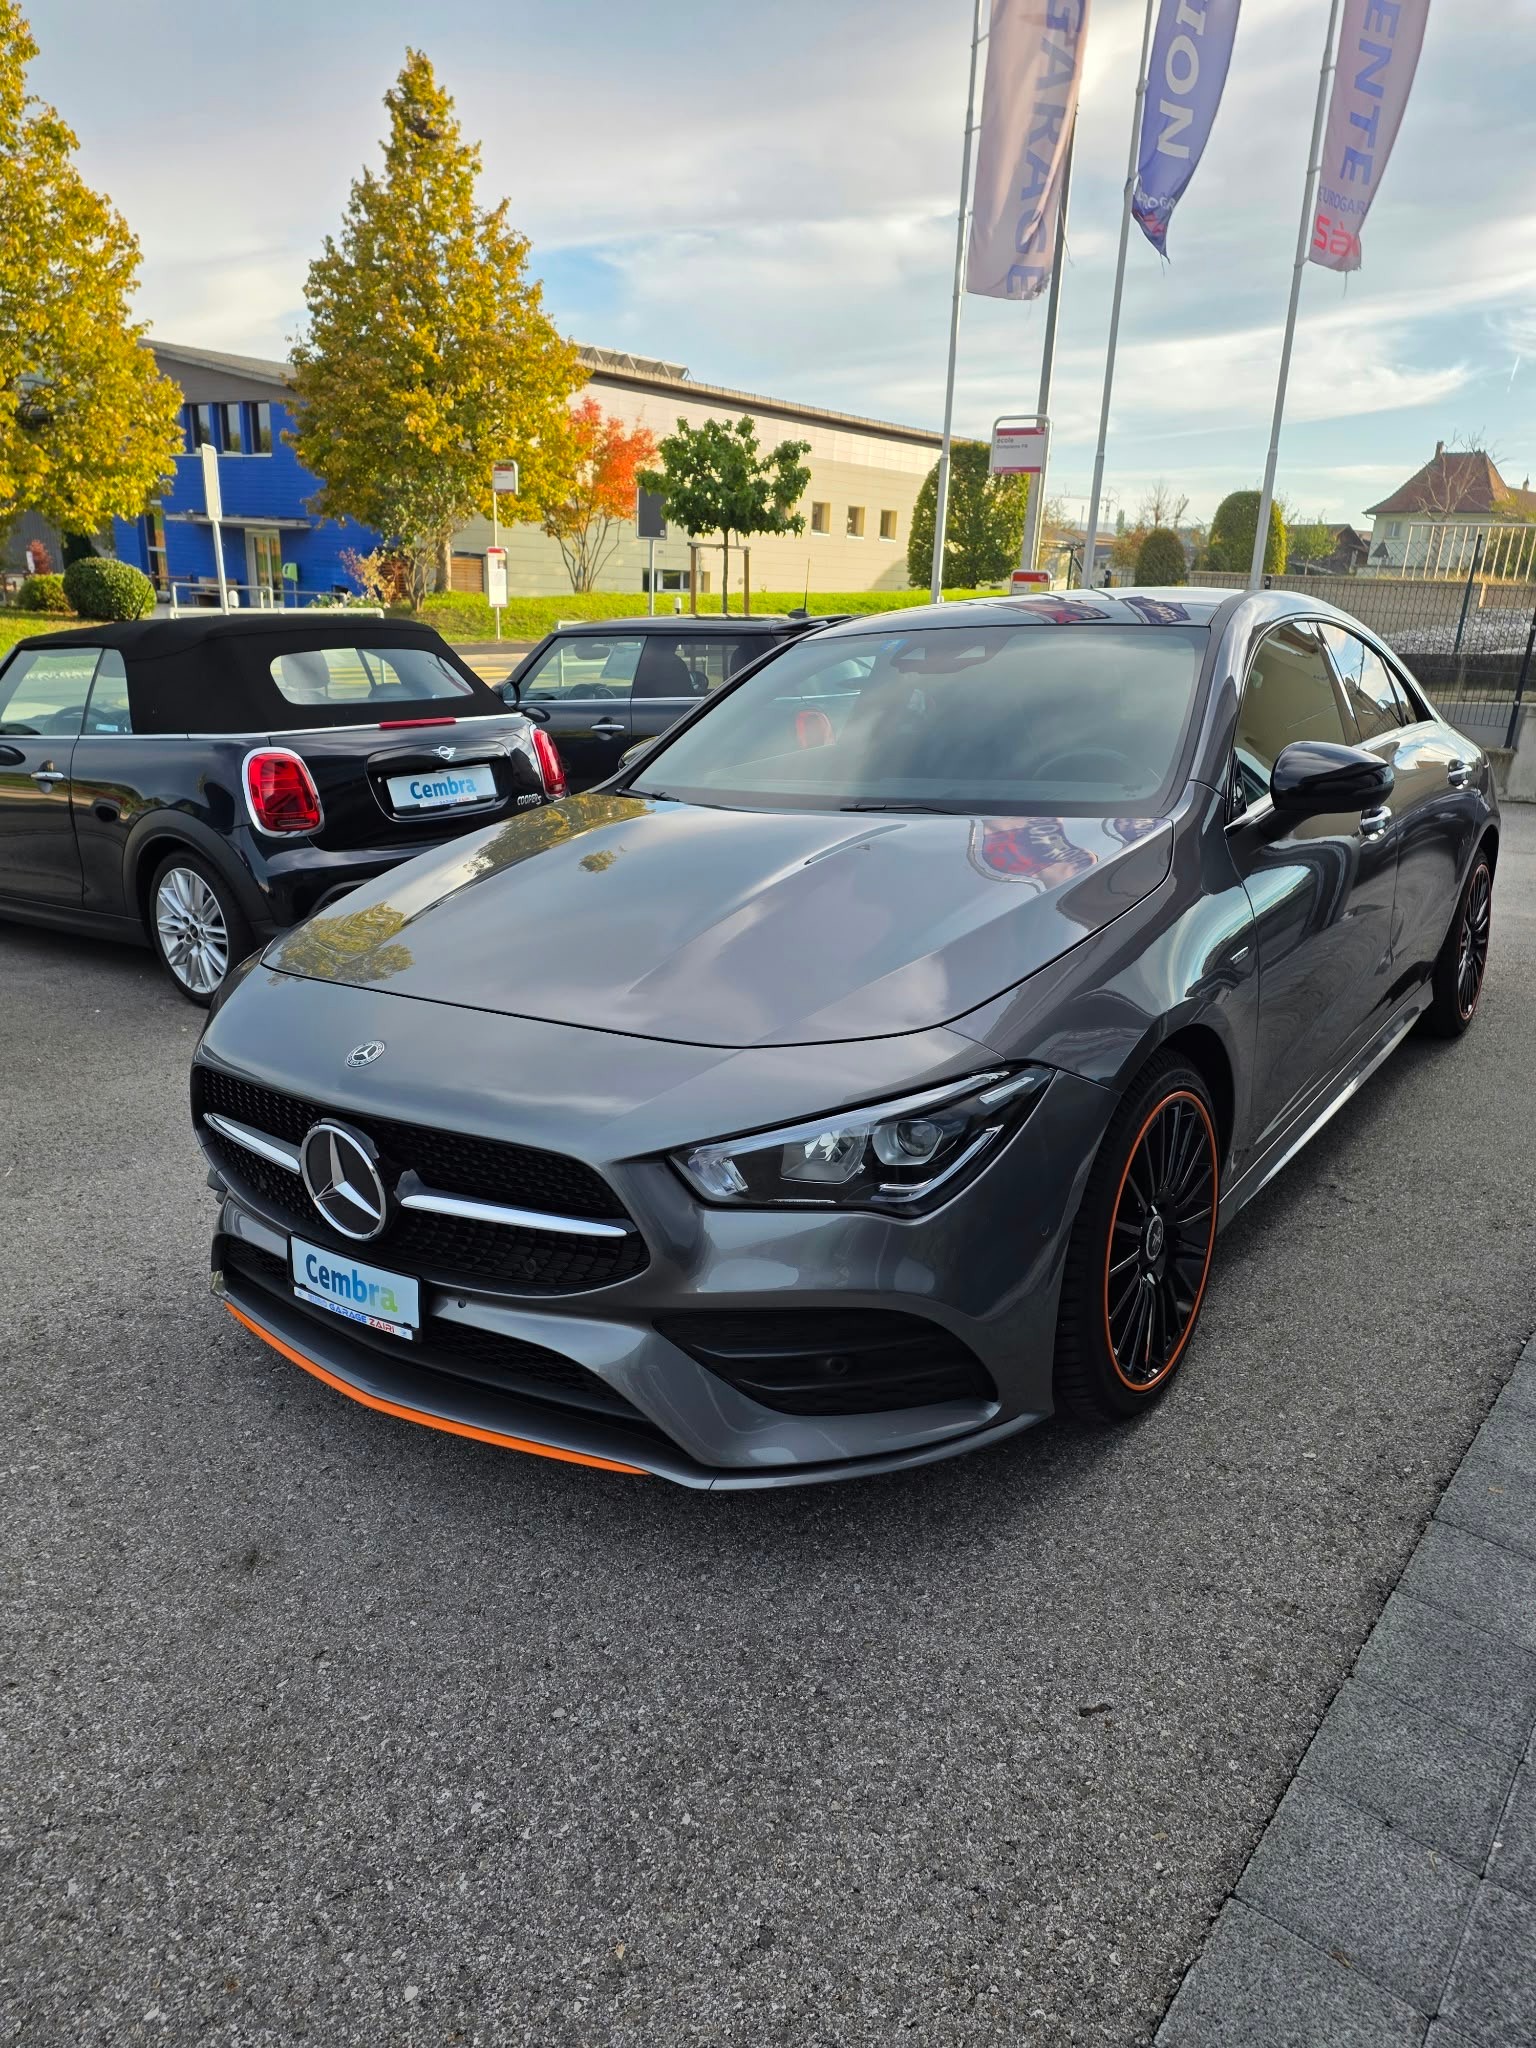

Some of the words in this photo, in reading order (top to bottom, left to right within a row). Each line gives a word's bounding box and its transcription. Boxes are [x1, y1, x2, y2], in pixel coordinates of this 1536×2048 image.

[410, 777, 477, 800] Cembra
[306, 1253, 398, 1313] Cembra
[329, 1302, 368, 1324] GARAGE
[369, 1317, 396, 1334] ZAIRI
